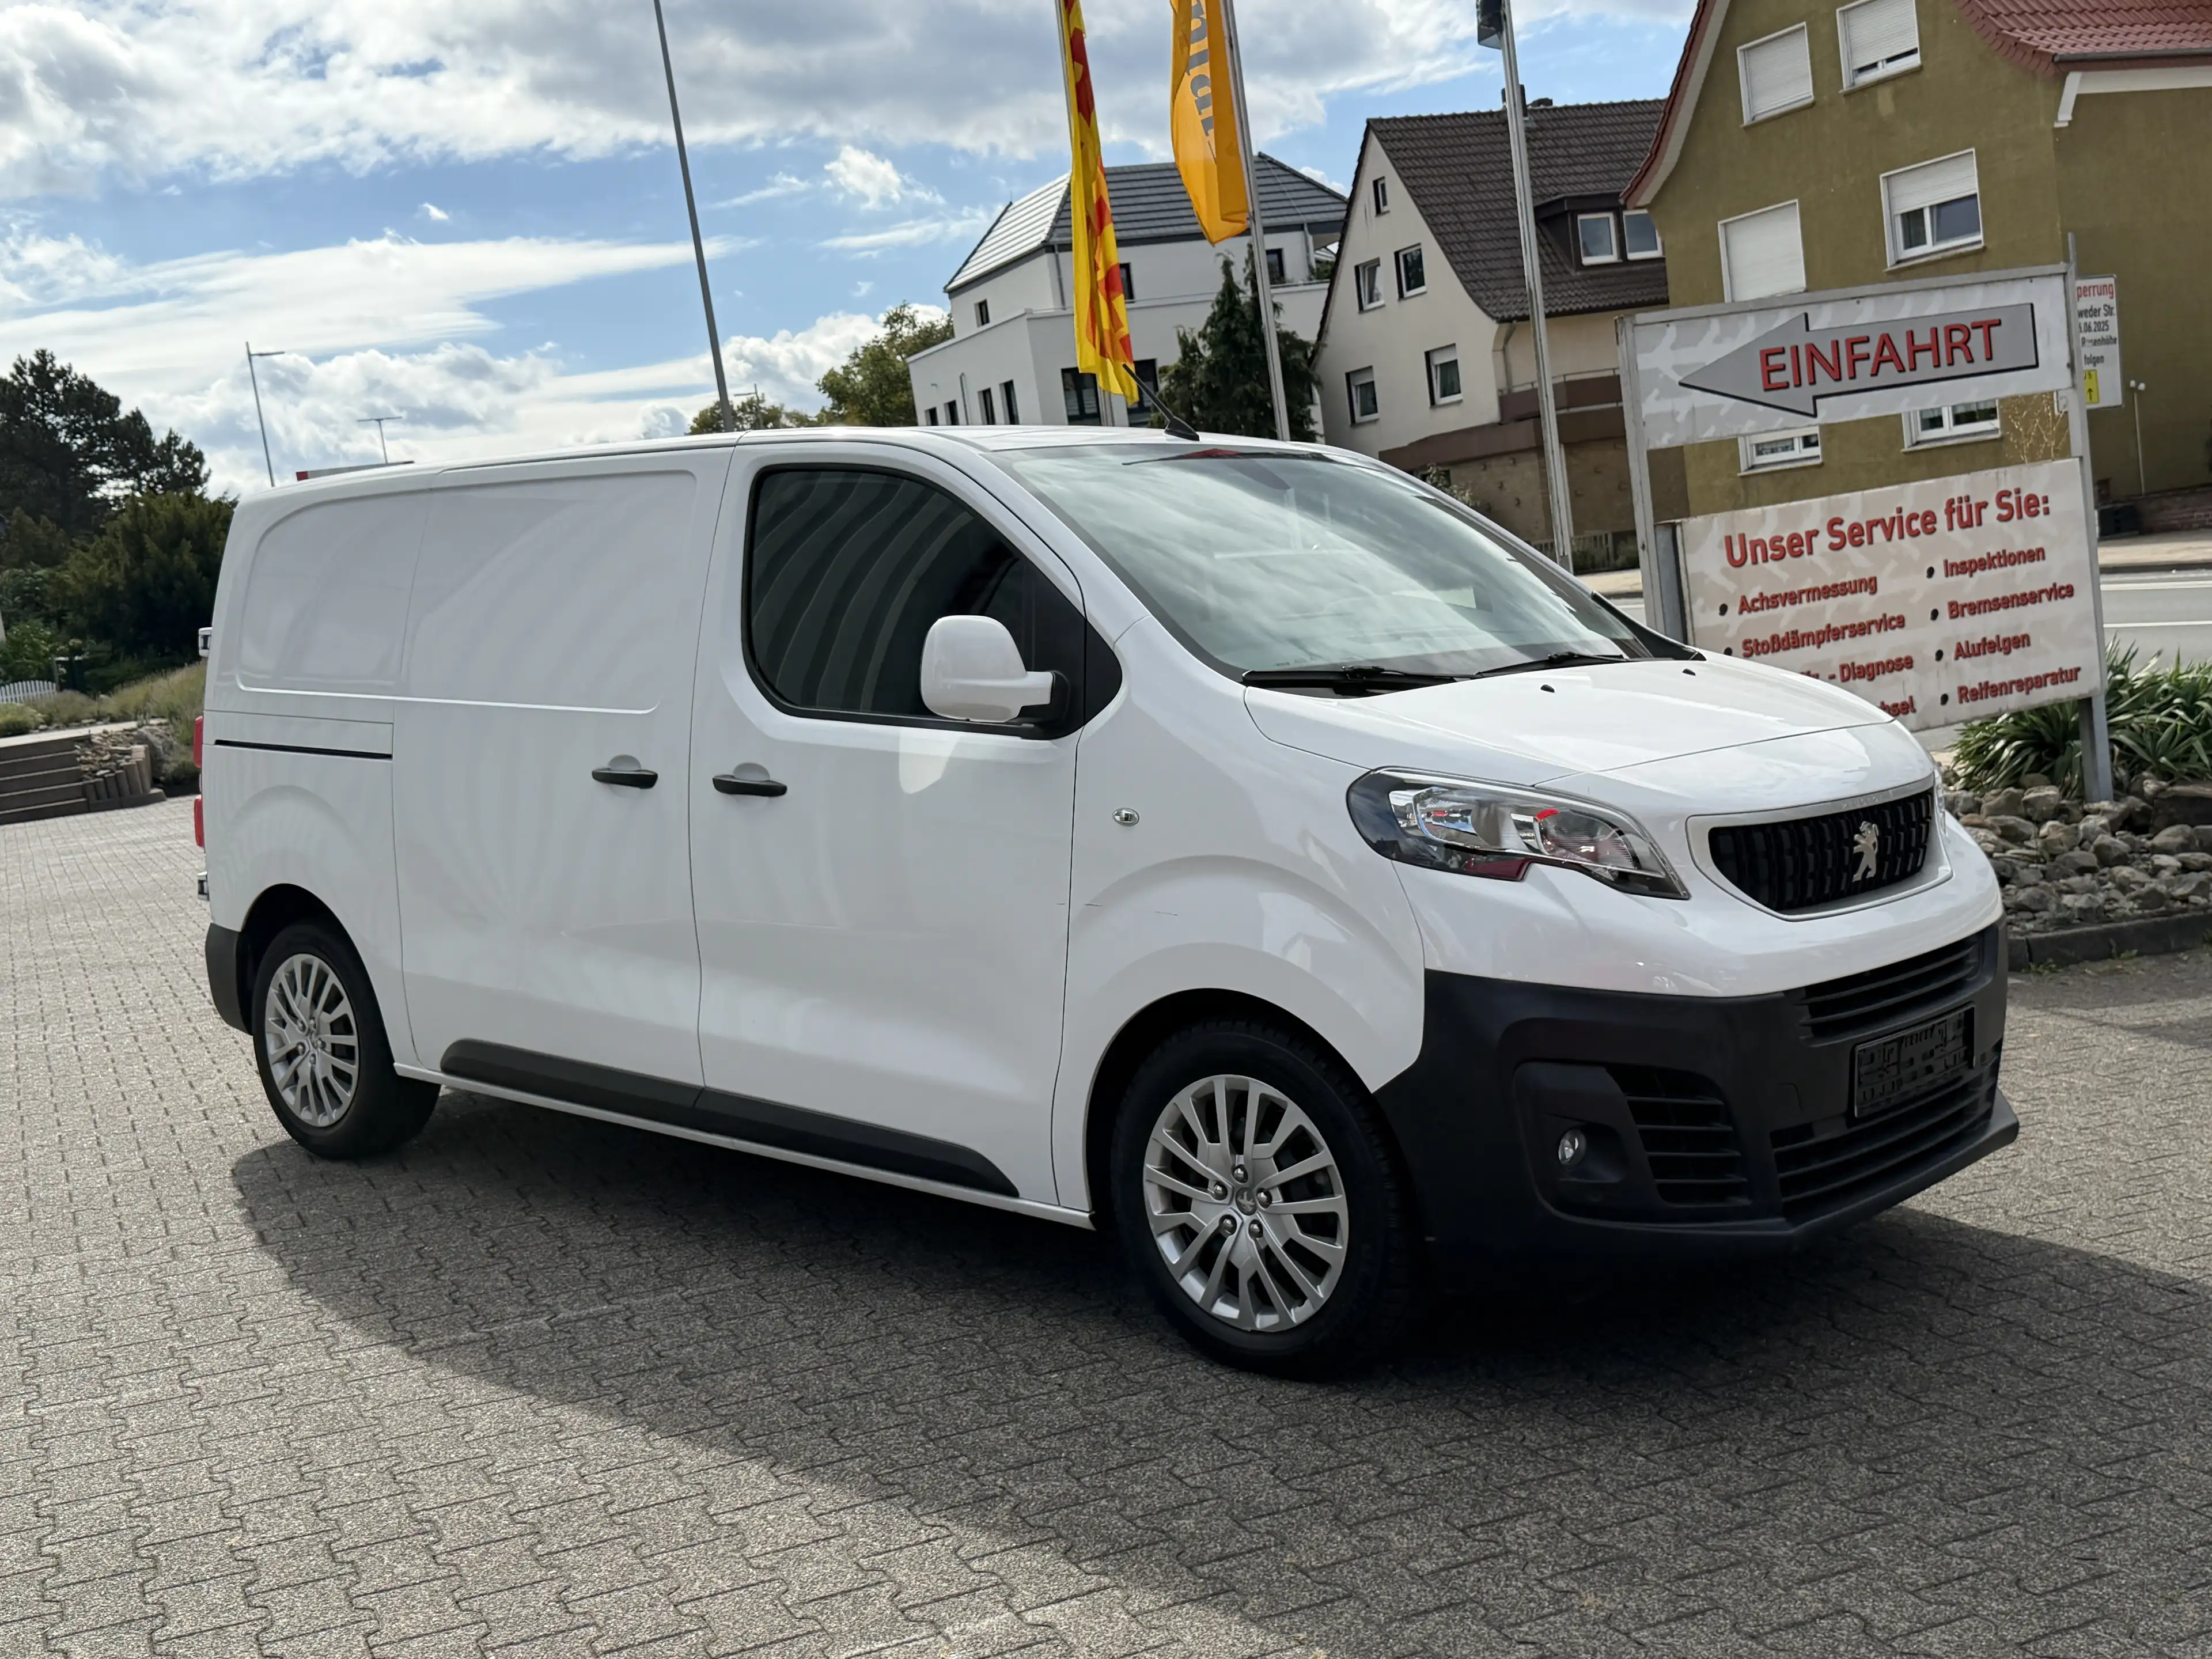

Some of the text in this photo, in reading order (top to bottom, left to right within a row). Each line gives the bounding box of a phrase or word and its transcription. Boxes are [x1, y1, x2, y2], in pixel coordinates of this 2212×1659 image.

[1759, 318, 2002, 392] EINFAHRT
[1724, 487, 2050, 567] Unser Service für Sie:
[1944, 546, 2046, 578] Inspektionen
[1738, 576, 1878, 615] Achsvermessung
[1947, 582, 2074, 619] Bremsenservice
[1742, 613, 1906, 658] Stoßdämpferservice
[1953, 633, 2031, 661] Alufelgen
[1839, 655, 1914, 683] Diagnose
[1957, 666, 2081, 704] Reifenreparatur
[1879, 695, 1916, 717] hsel
